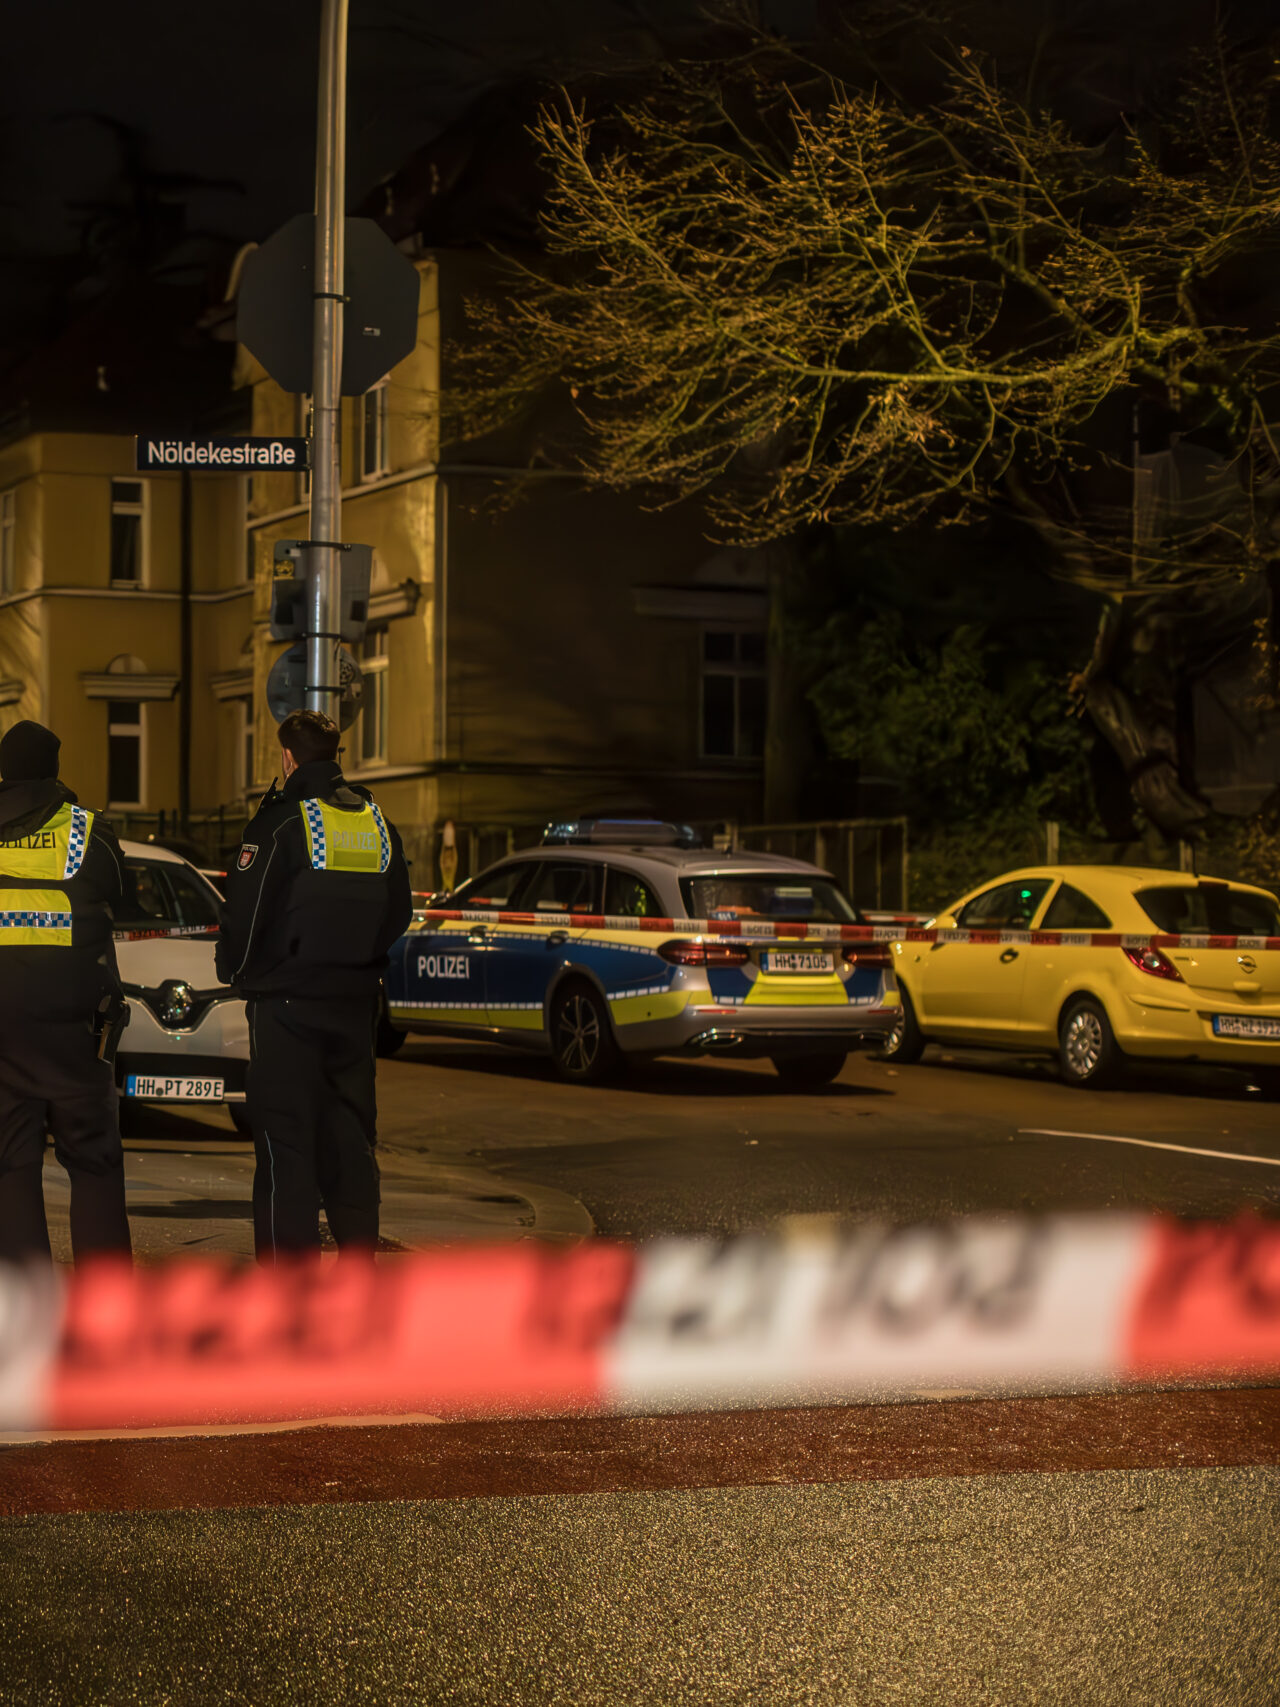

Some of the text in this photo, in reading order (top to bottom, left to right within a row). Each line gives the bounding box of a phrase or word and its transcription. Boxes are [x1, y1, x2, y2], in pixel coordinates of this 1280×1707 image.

[147, 441, 296, 464] Nöldekestraße
[333, 831, 377, 850] POLIZEI
[418, 955, 470, 979] POLIZEI
[186, 1081, 222, 1097] 289E
